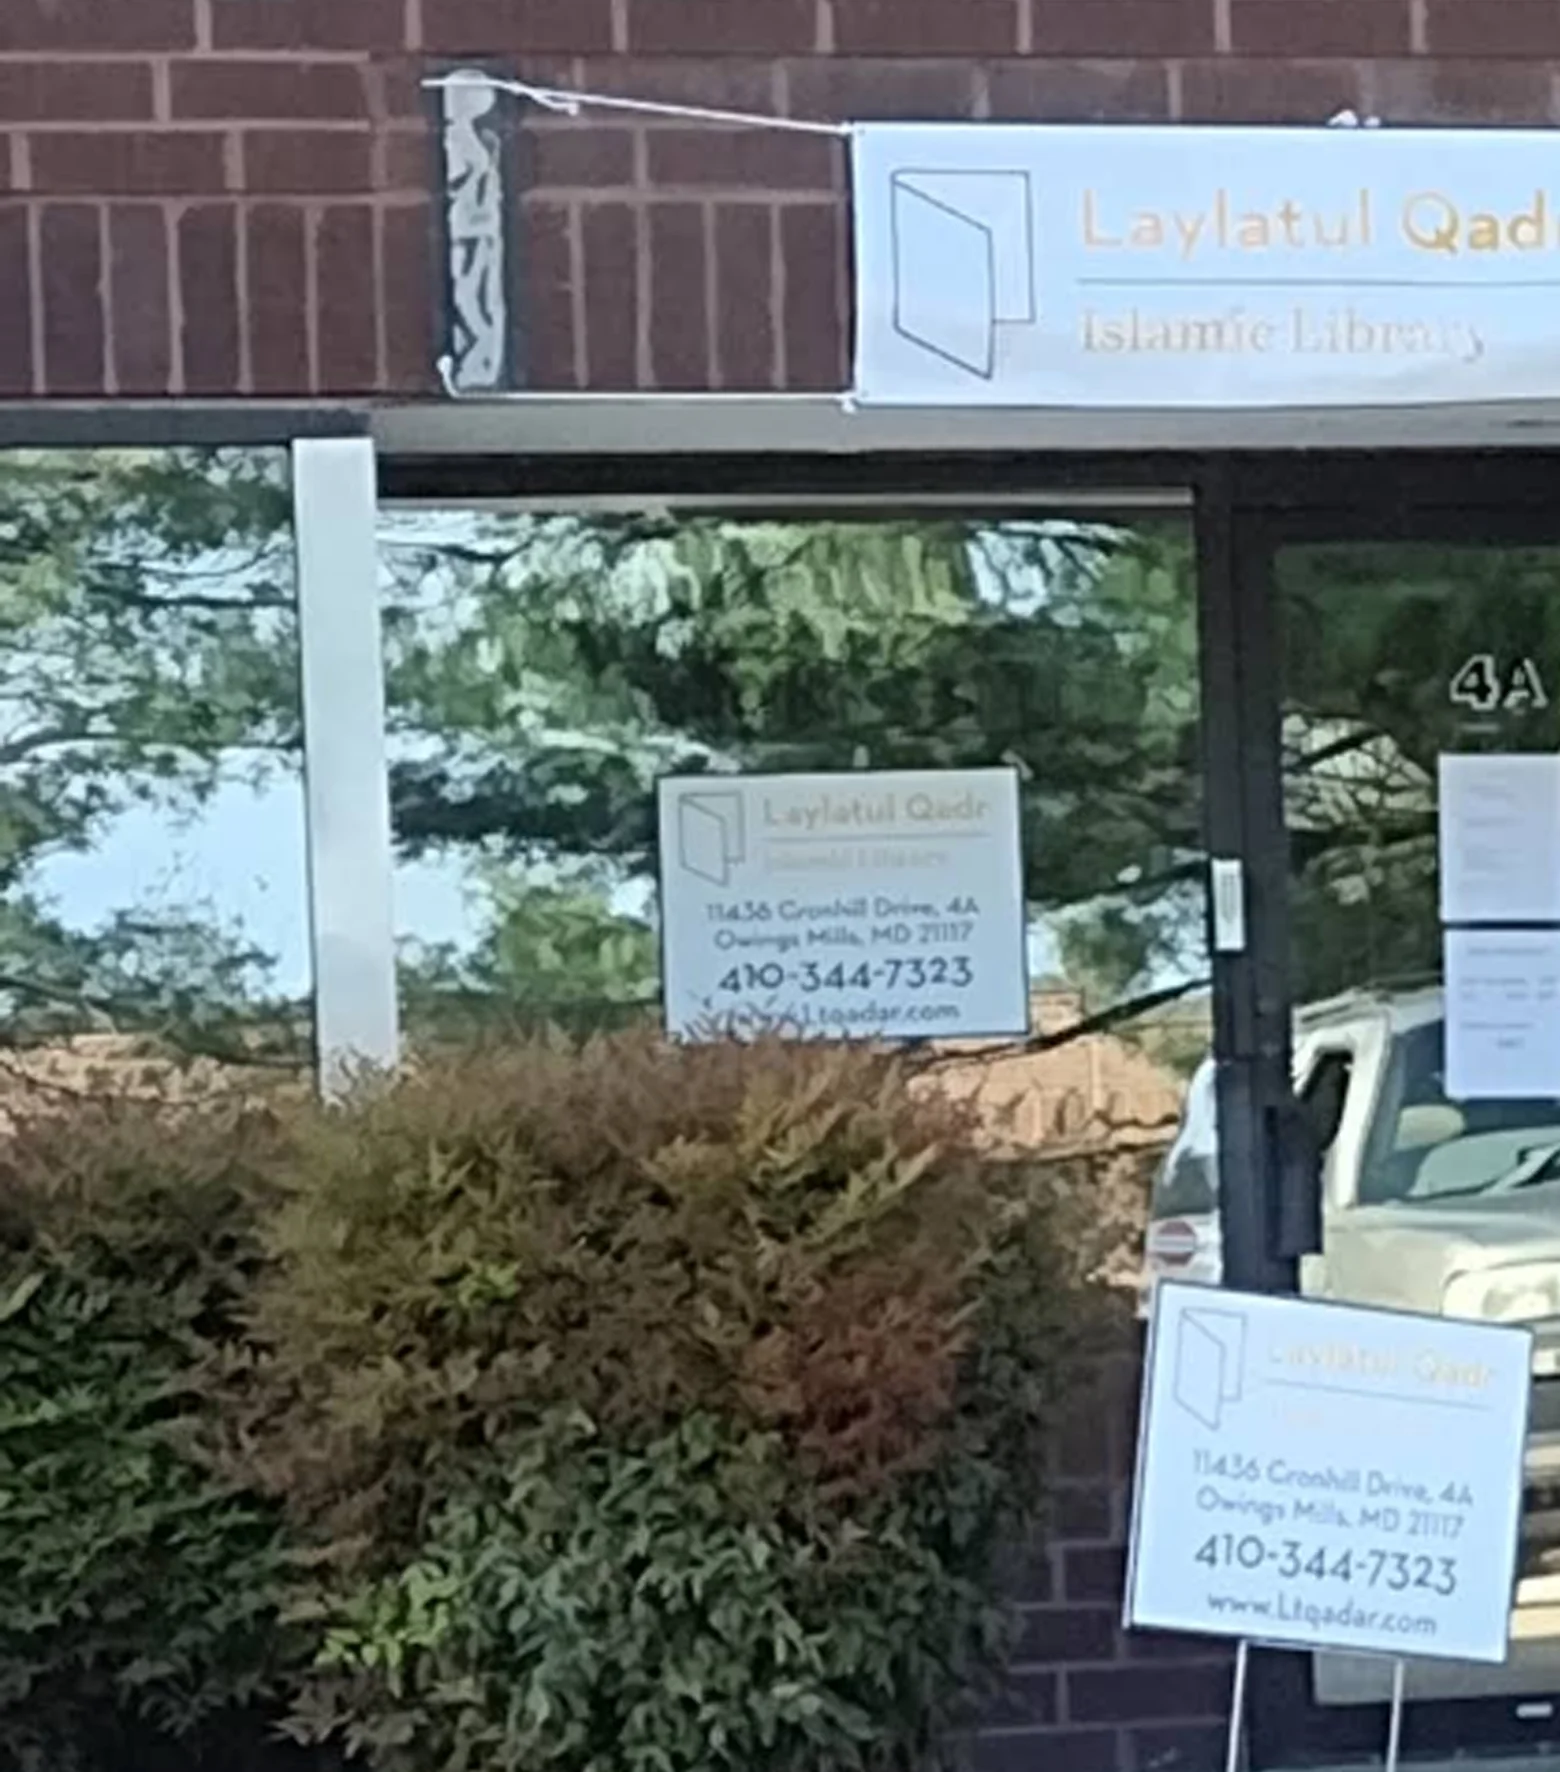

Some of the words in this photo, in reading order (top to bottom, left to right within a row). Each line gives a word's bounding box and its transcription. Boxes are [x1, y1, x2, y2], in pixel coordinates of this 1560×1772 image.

[1081, 187, 1373, 262] Laylatul
[1080, 306, 1277, 355] Islamic
[1291, 307, 1488, 362] Library
[1449, 653, 1549, 713] 4A
[873, 896, 941, 919] Drive,
[945, 895, 981, 915] 4A
[870, 923, 912, 945] MD
[718, 955, 975, 994] 410-344-7323
[1193, 1448, 1261, 1483] 11436
[1438, 1481, 1474, 1506] 4A
[1357, 1507, 1400, 1533] MD
[1407, 1509, 1466, 1539] 21117
[1194, 1533, 1459, 1596] 410-344-7323
[1206, 1590, 1438, 1636] www.Ltqadar.com
